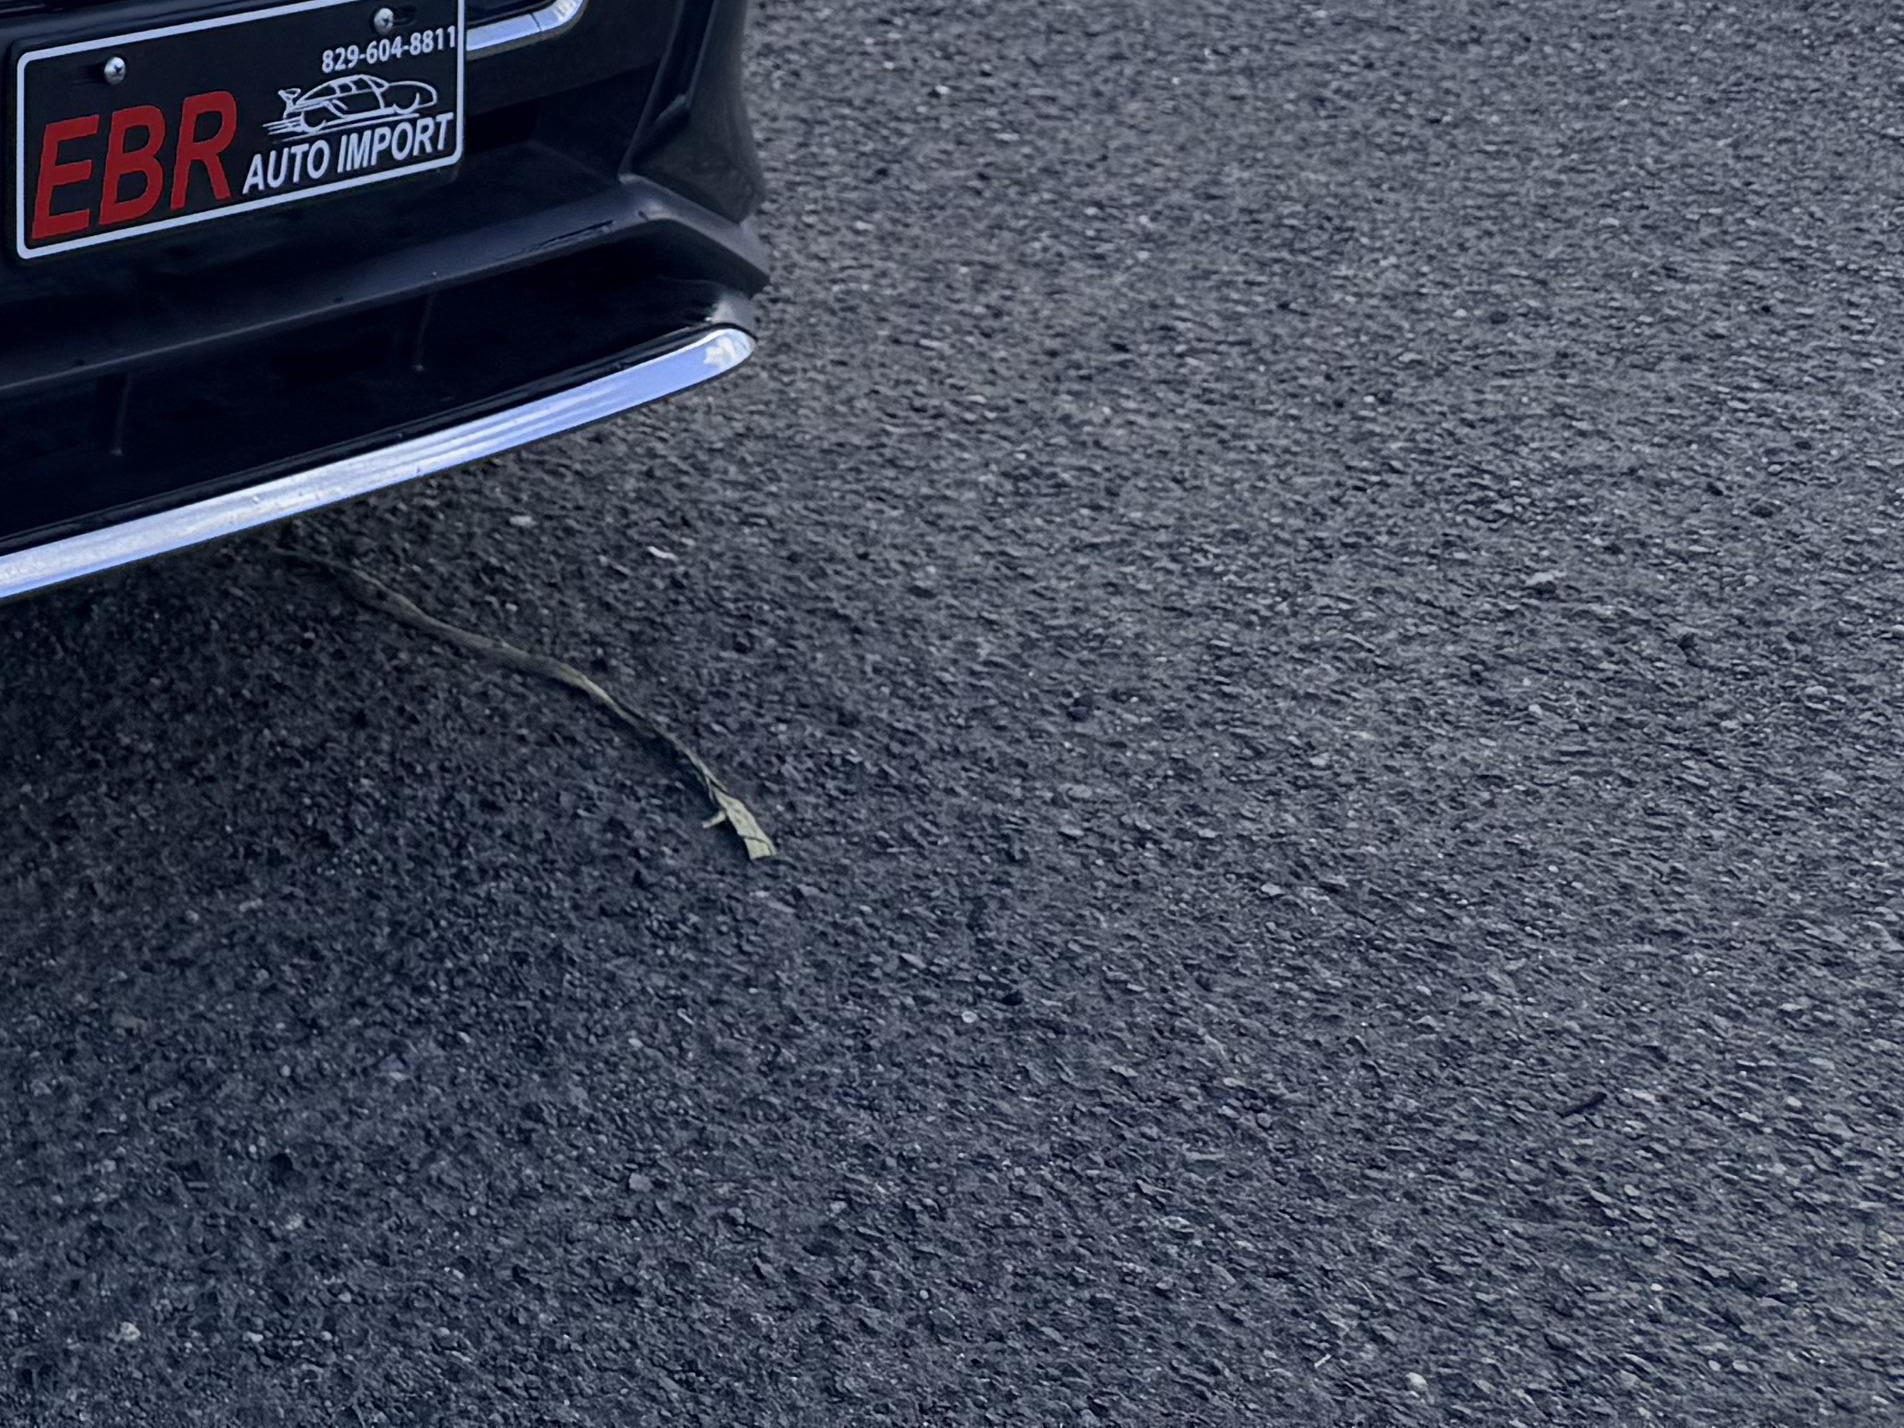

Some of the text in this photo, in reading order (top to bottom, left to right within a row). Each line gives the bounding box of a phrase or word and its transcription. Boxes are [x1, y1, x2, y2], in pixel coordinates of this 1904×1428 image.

[321, 25, 456, 74] 829-604-8811
[31, 90, 238, 240] EBR
[242, 112, 454, 195] AUTO IMPORT
